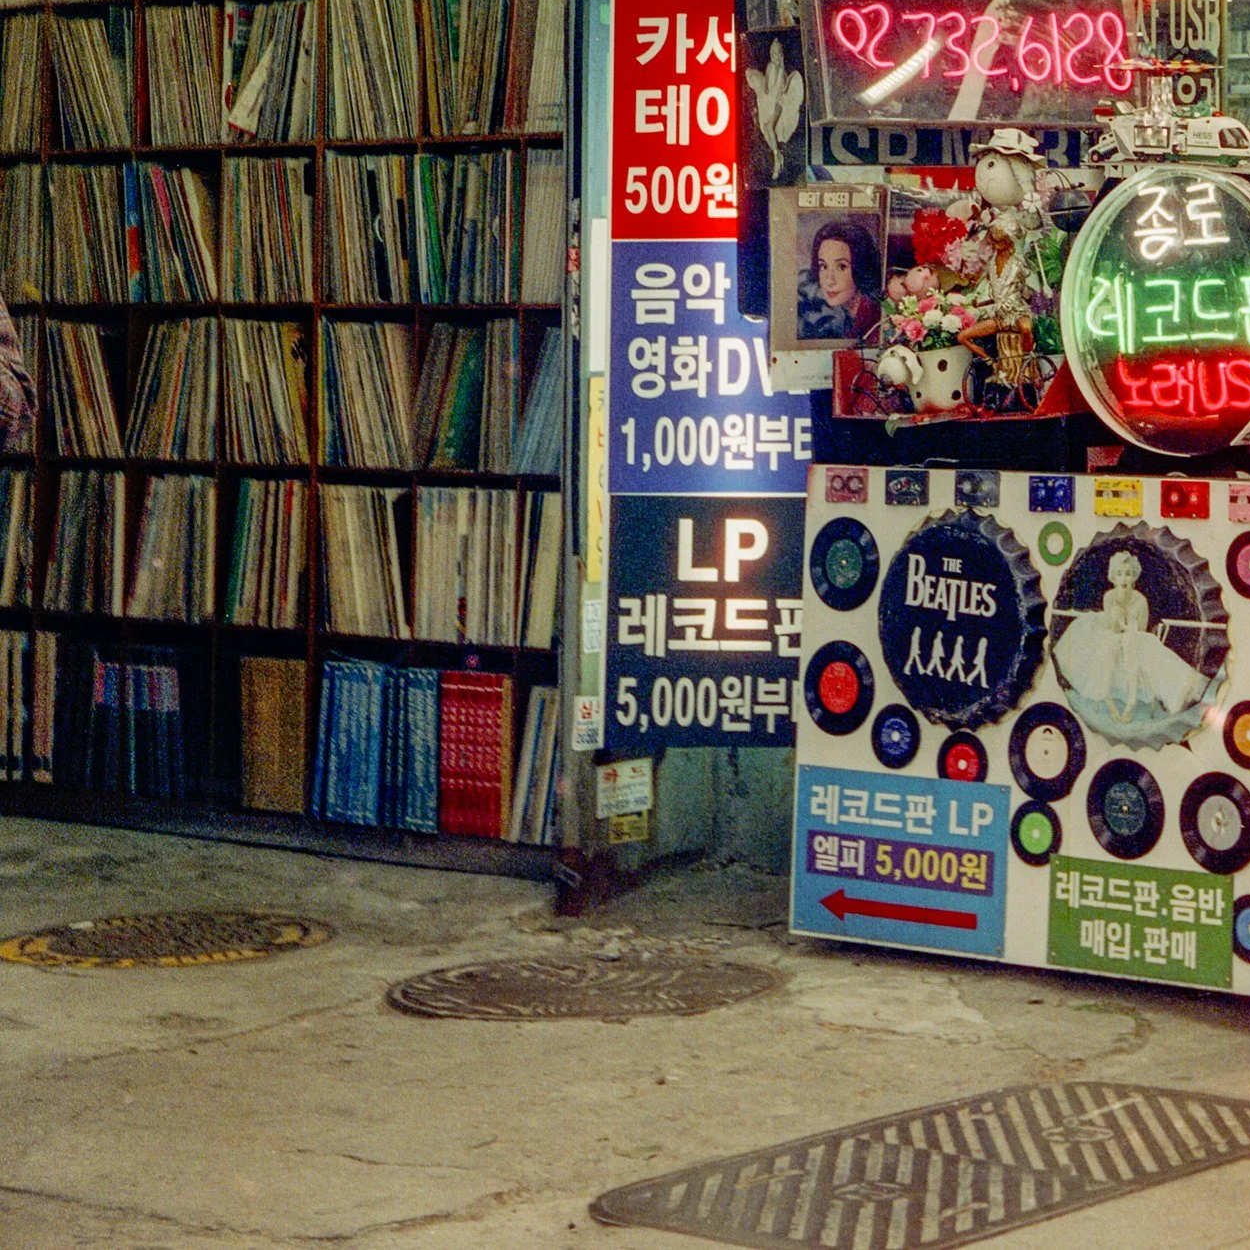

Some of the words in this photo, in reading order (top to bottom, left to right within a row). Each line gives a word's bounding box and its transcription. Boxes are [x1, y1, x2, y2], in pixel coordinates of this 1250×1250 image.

[835, 2, 895, 69] 02
[902, 10, 1133, 92] 732.6128
[624, 161, 738, 220] 500원
[1133, 181, 1231, 260] 종로
[631, 262, 731, 326] 음악
[677, 518, 769, 583] LP
[941, 556, 963, 575] THE
[905, 553, 998, 622] BEATLES
[616, 674, 800, 734] 5,000원부
[809, 783, 938, 837] 레코드판
[948, 800, 994, 837] LP
[812, 835, 867, 877] 엘피
[874, 844, 990, 892] 5,000원
